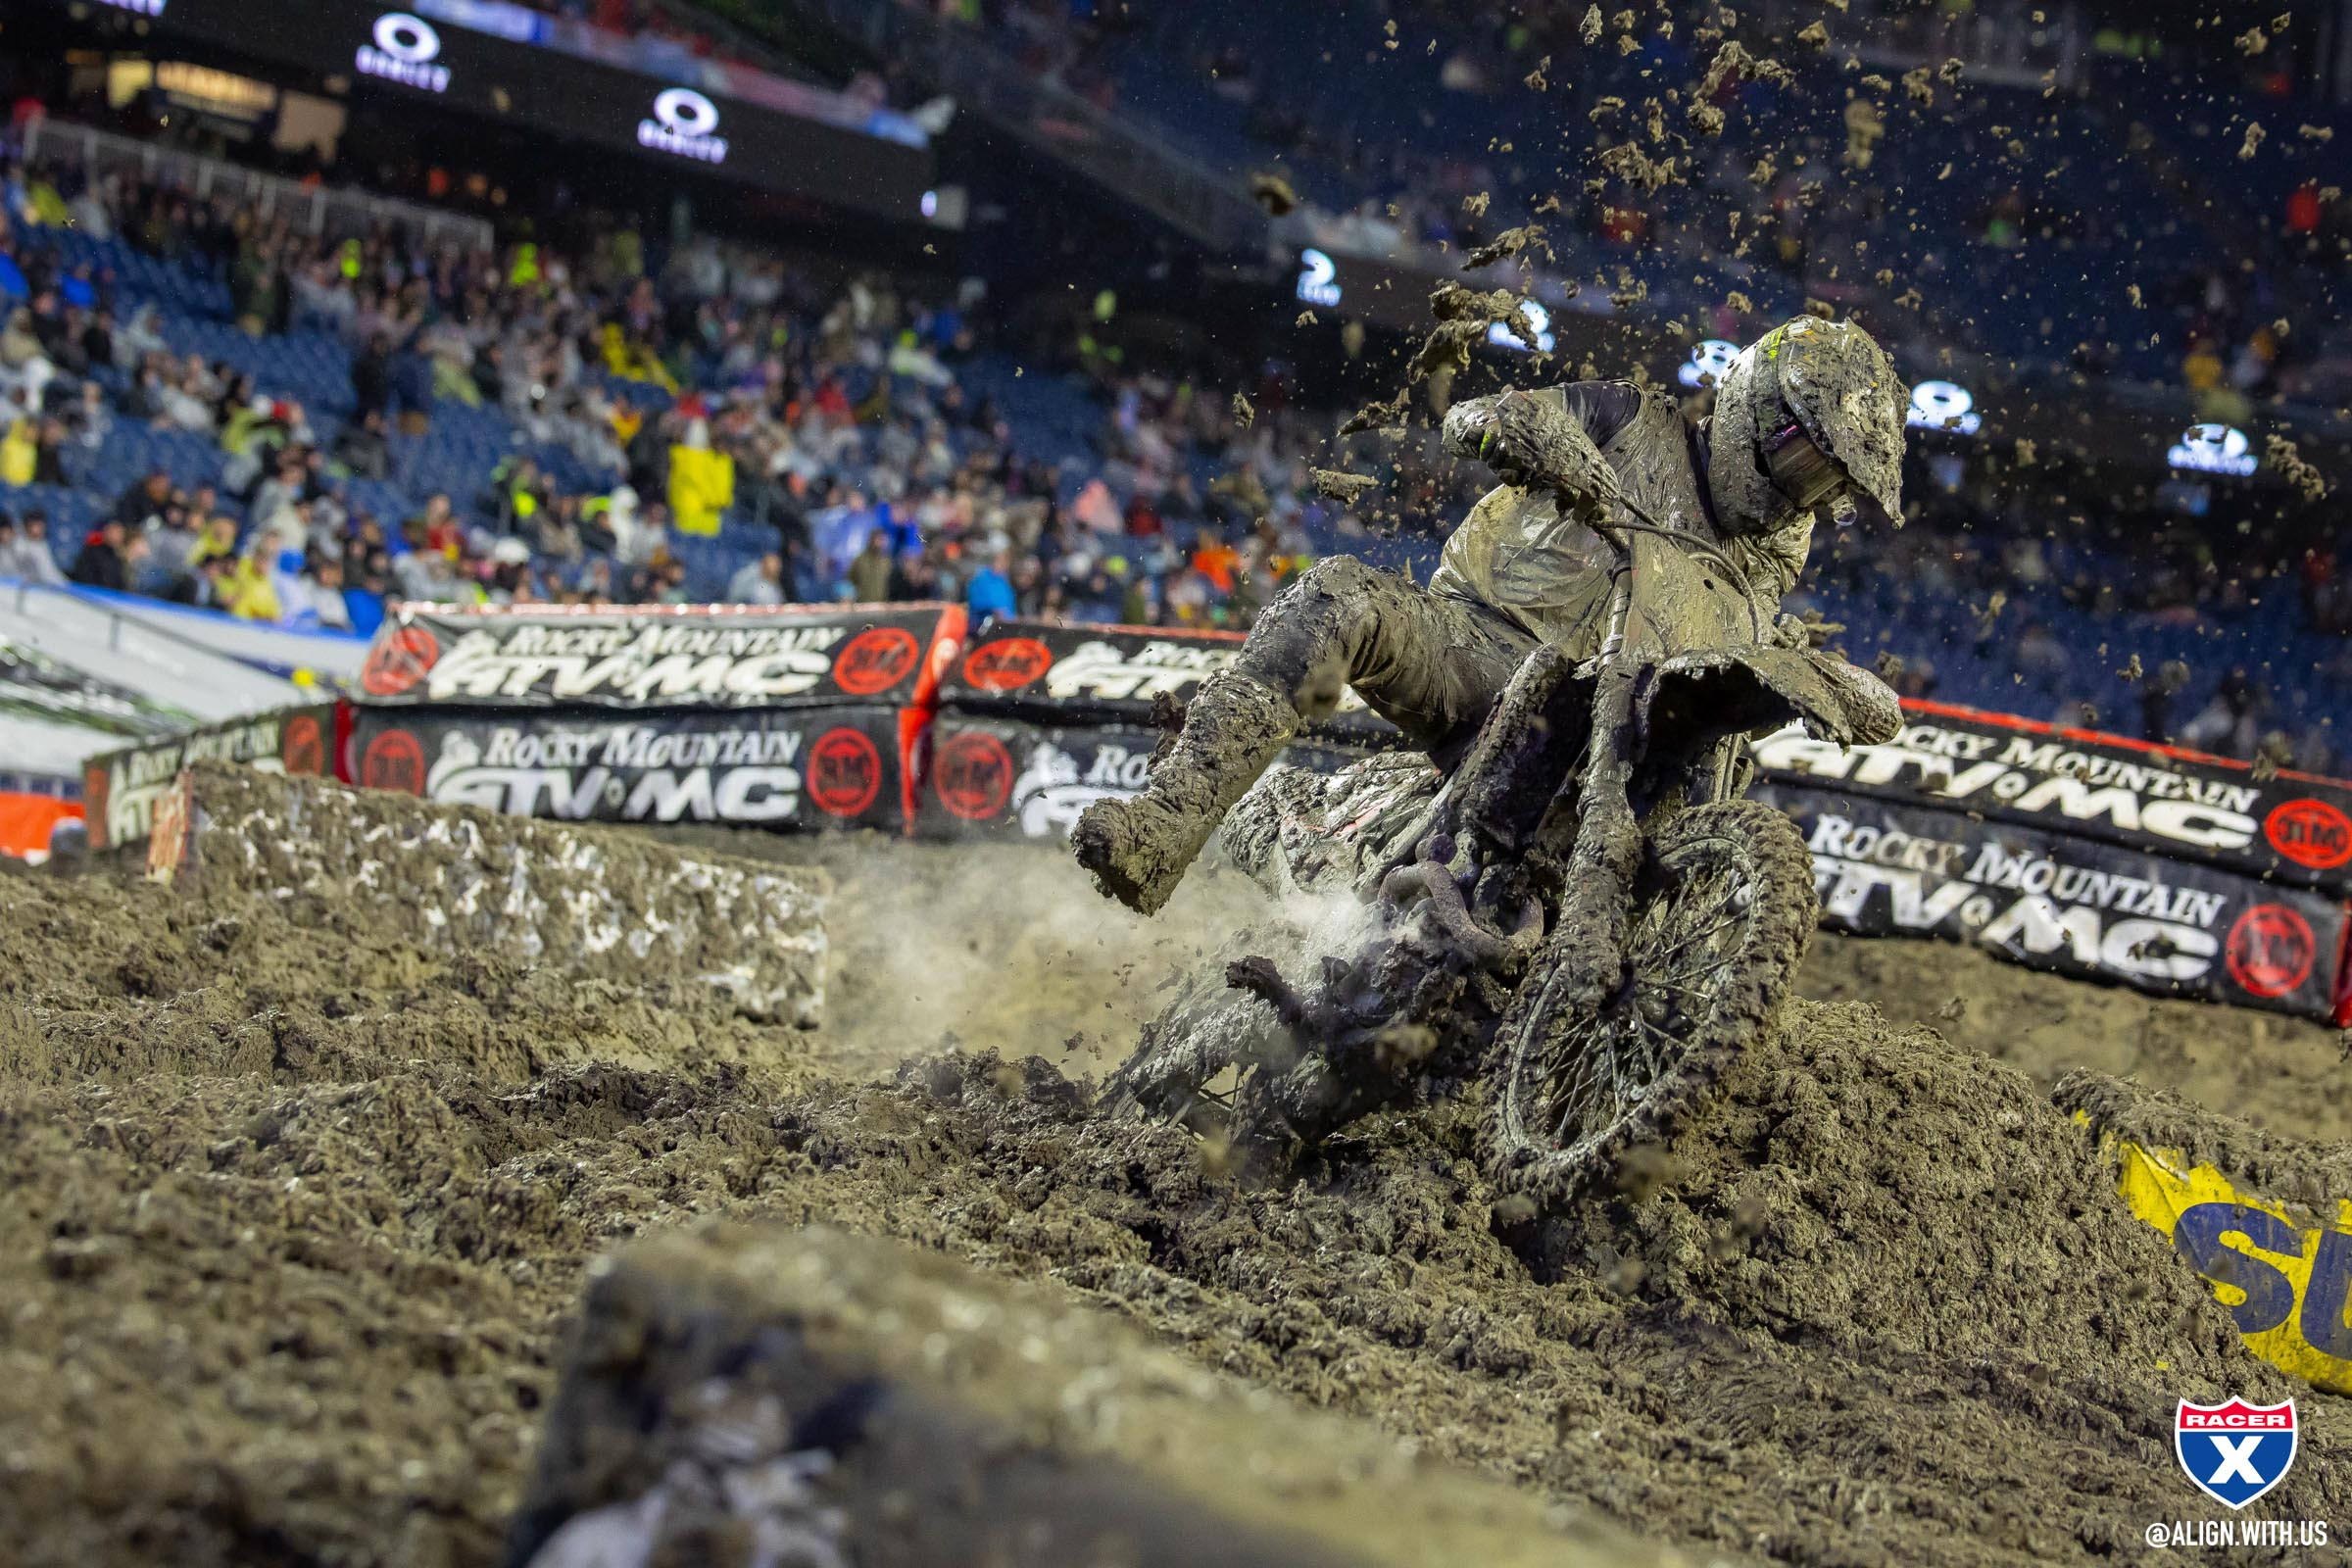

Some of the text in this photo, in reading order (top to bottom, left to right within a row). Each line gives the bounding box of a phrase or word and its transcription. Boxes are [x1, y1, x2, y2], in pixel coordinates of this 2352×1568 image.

[483, 725, 802, 768] ROCKY MOUNTAIN
[1996, 736, 2260, 813] MOUNTAIN
[1810, 812, 2227, 928] ROCKY MOUNTAIN
